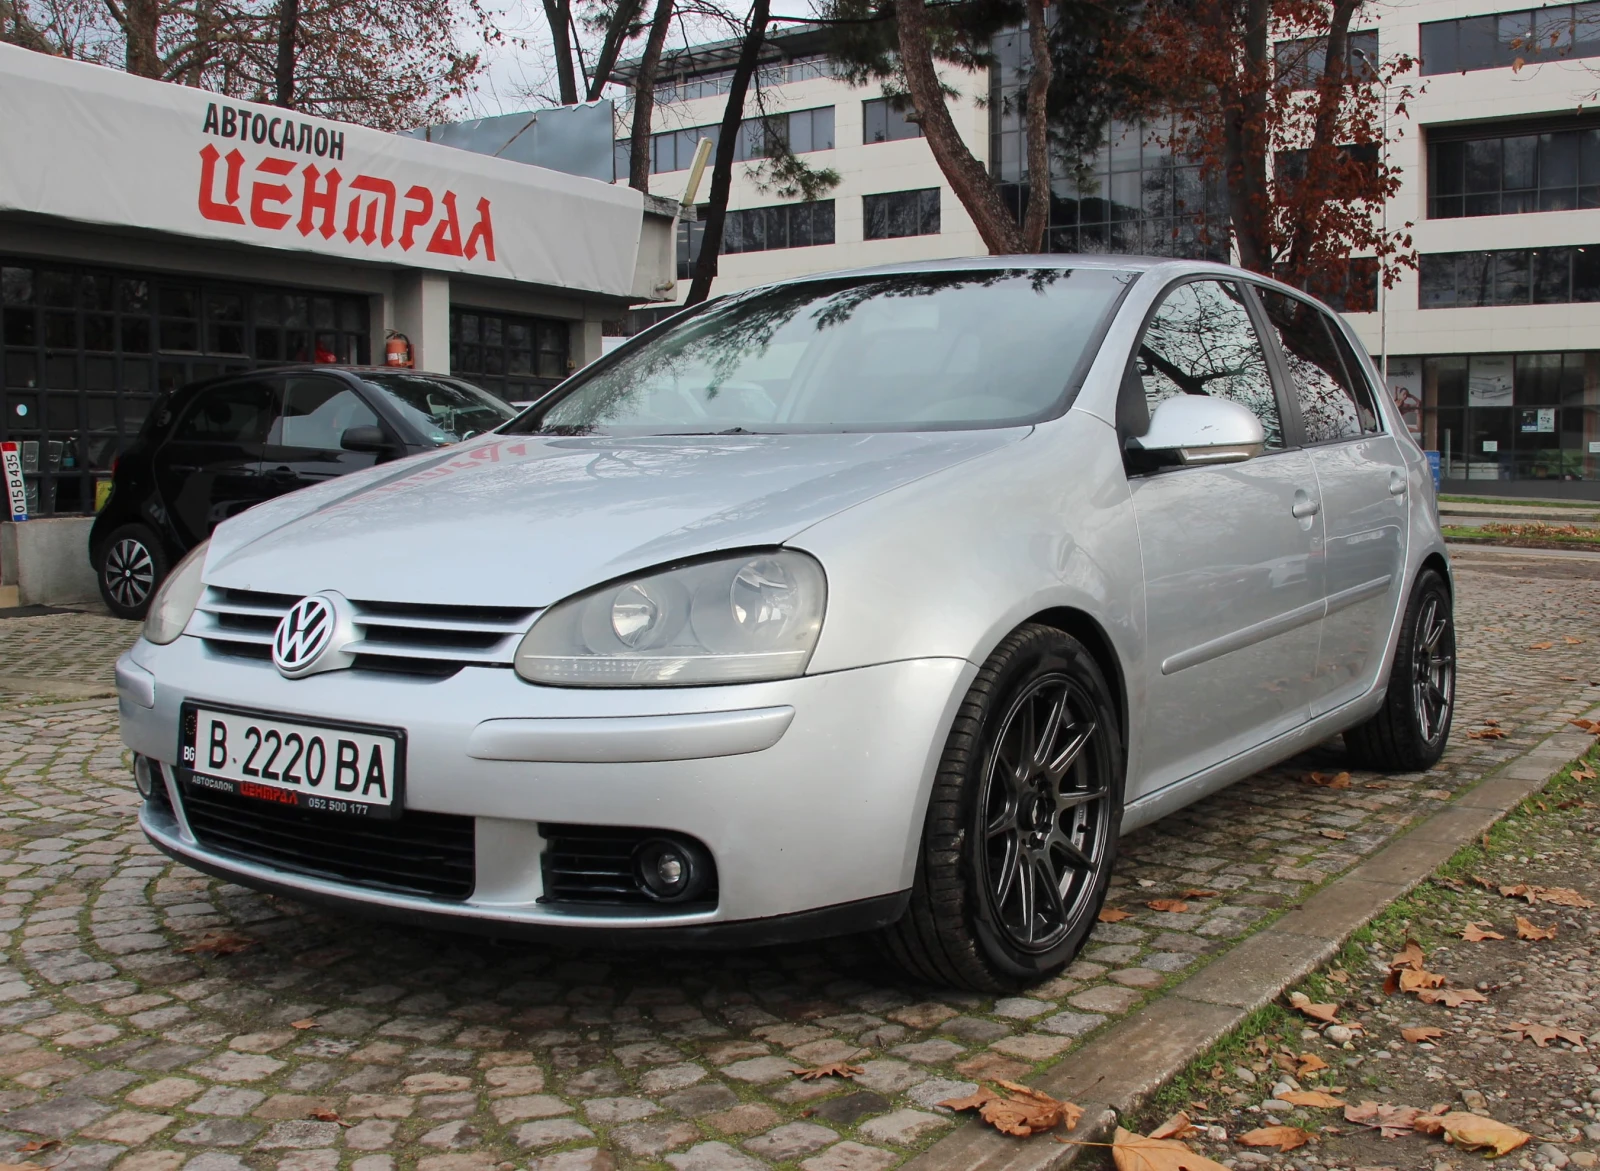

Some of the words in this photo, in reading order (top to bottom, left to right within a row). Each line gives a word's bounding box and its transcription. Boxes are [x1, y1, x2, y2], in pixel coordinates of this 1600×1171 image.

[203, 102, 345, 161] АВТОСАЛОН
[198, 143, 496, 262] ЦЕНТРАЛ
[12, 490, 25, 513] 015
[183, 745, 195, 762] BG
[208, 719, 228, 769] B
[241, 726, 326, 787] 2220
[334, 739, 388, 798] BA
[191, 775, 234, 793] АВТОСАЛОН
[240, 781, 299, 805] ЦЕНТРАЛ
[308, 797, 326, 810] 052
[328, 800, 347, 813] 500
[349, 803, 368, 815] 177
